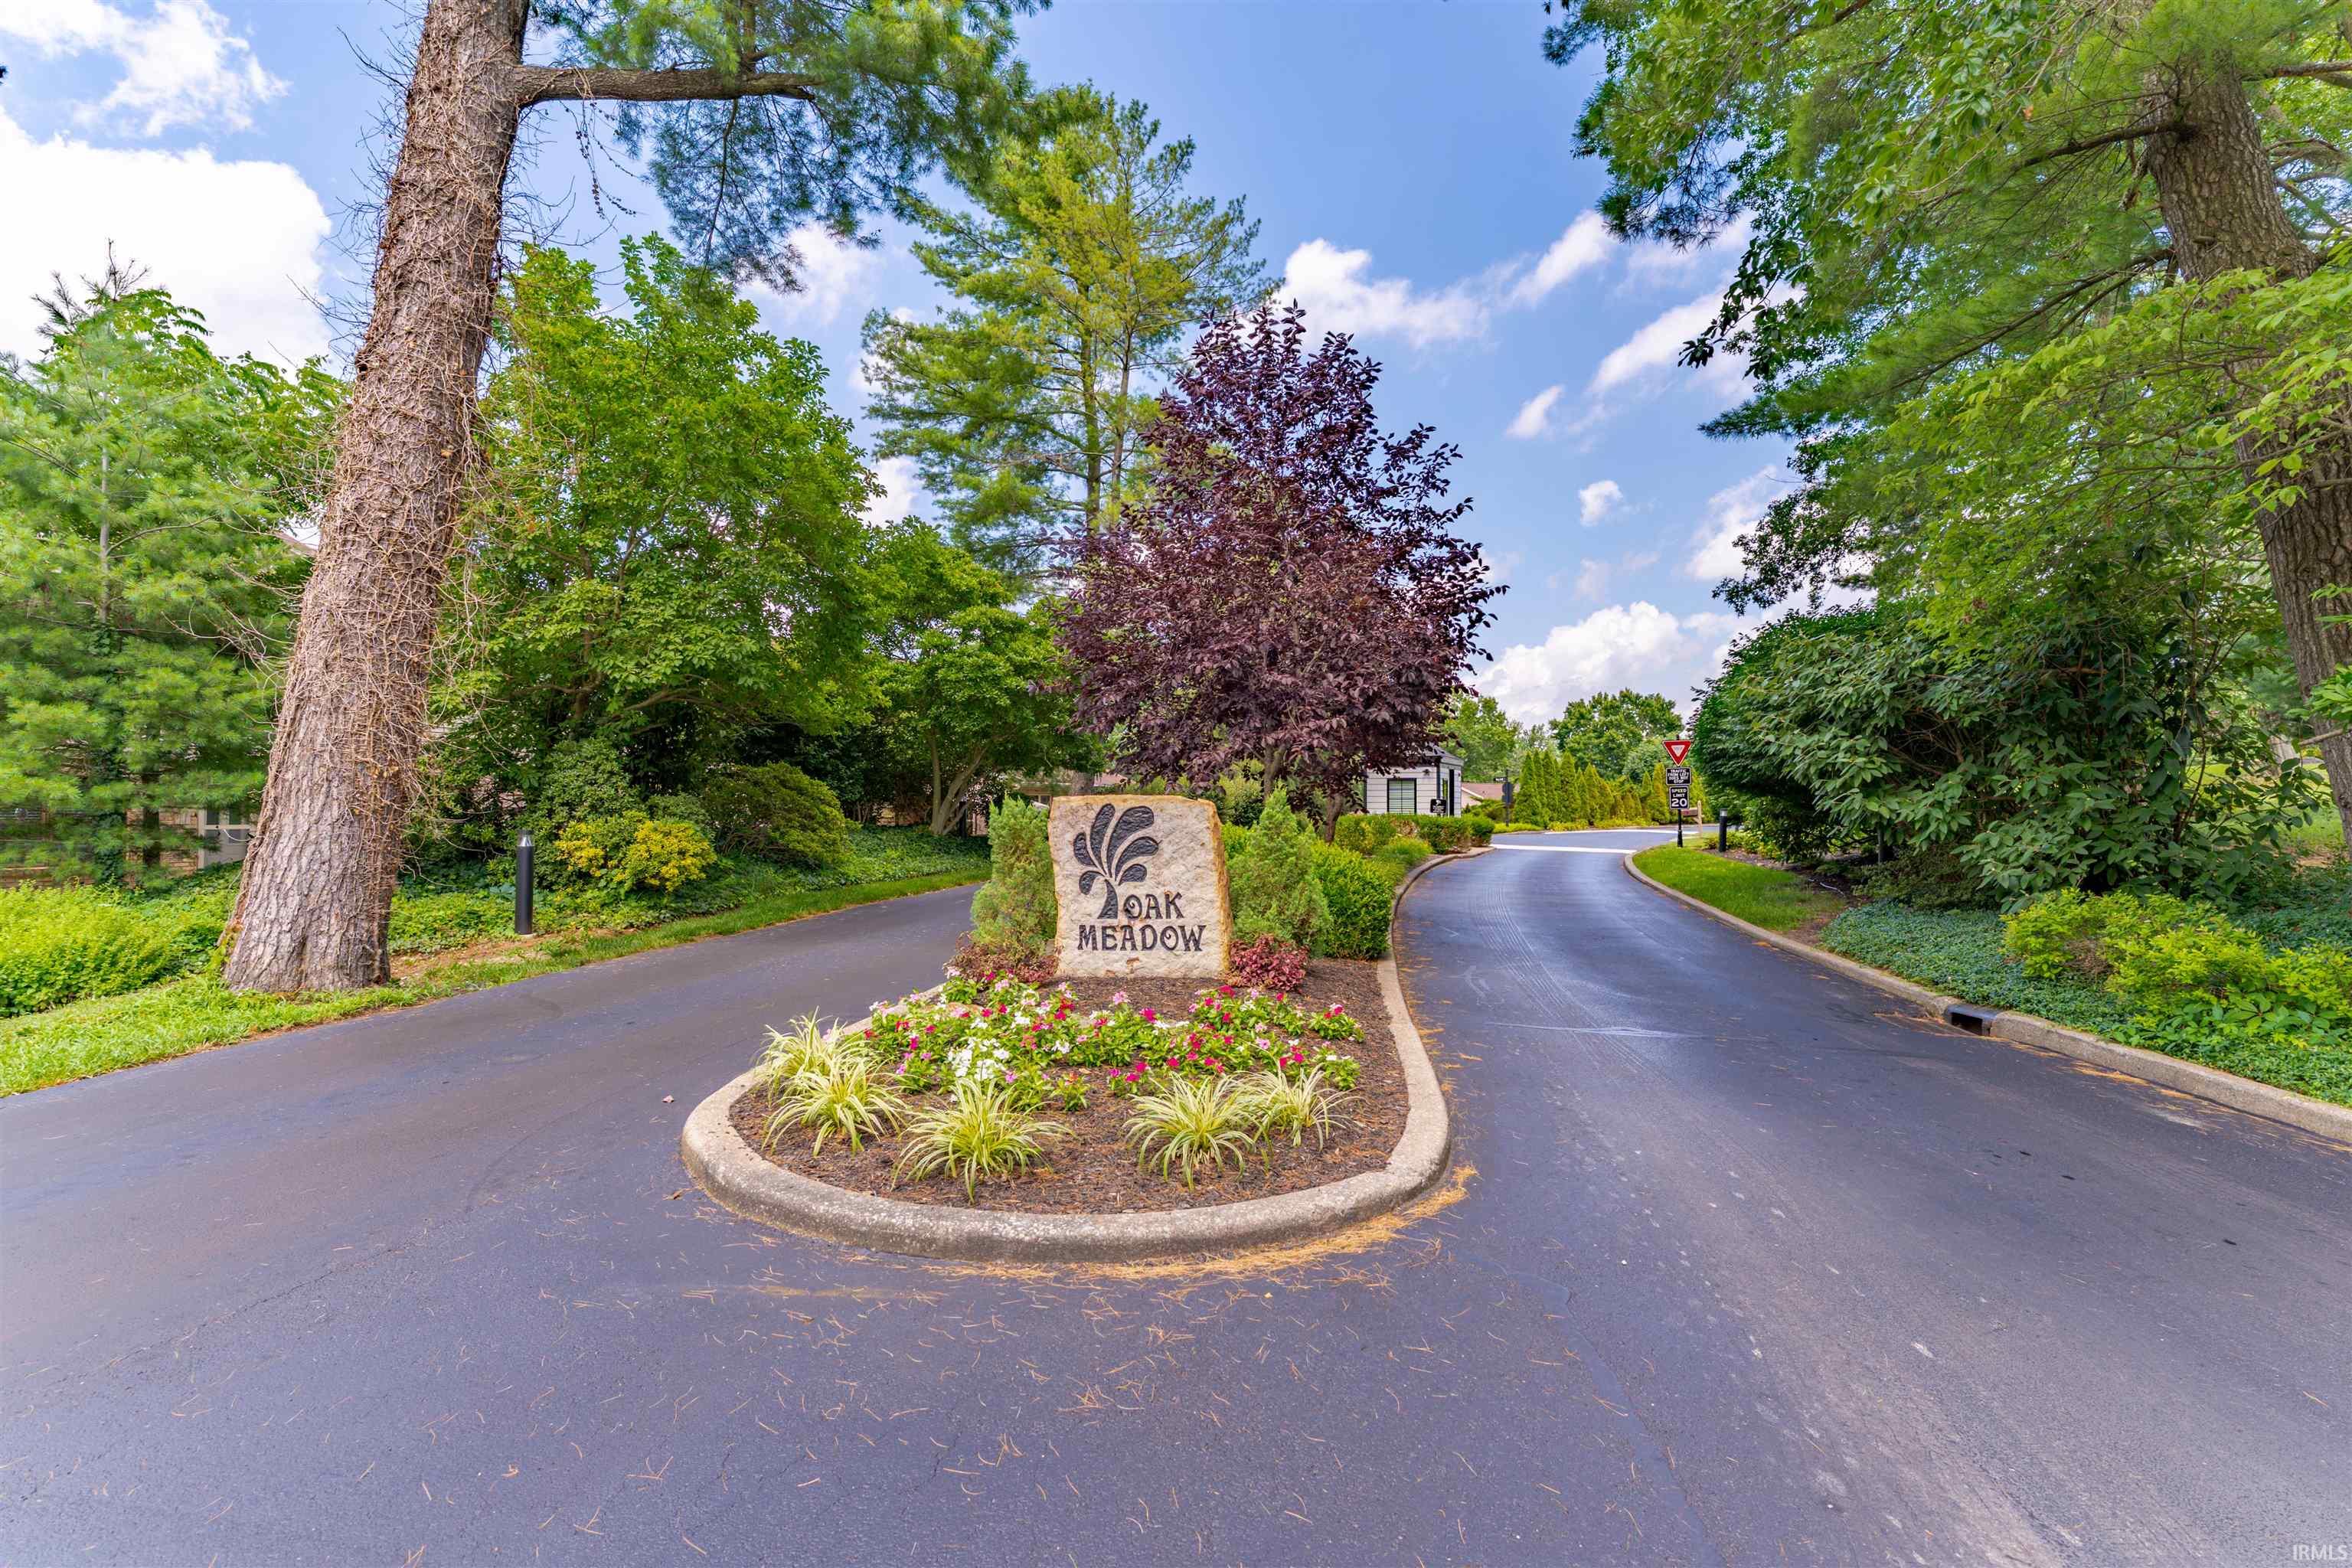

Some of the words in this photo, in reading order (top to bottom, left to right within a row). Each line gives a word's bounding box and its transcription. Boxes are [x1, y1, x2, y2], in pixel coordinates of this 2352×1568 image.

[1671, 798, 1687, 807] 20
[1122, 891, 1184, 920] OAK
[1077, 924, 1207, 952] MEADOW
